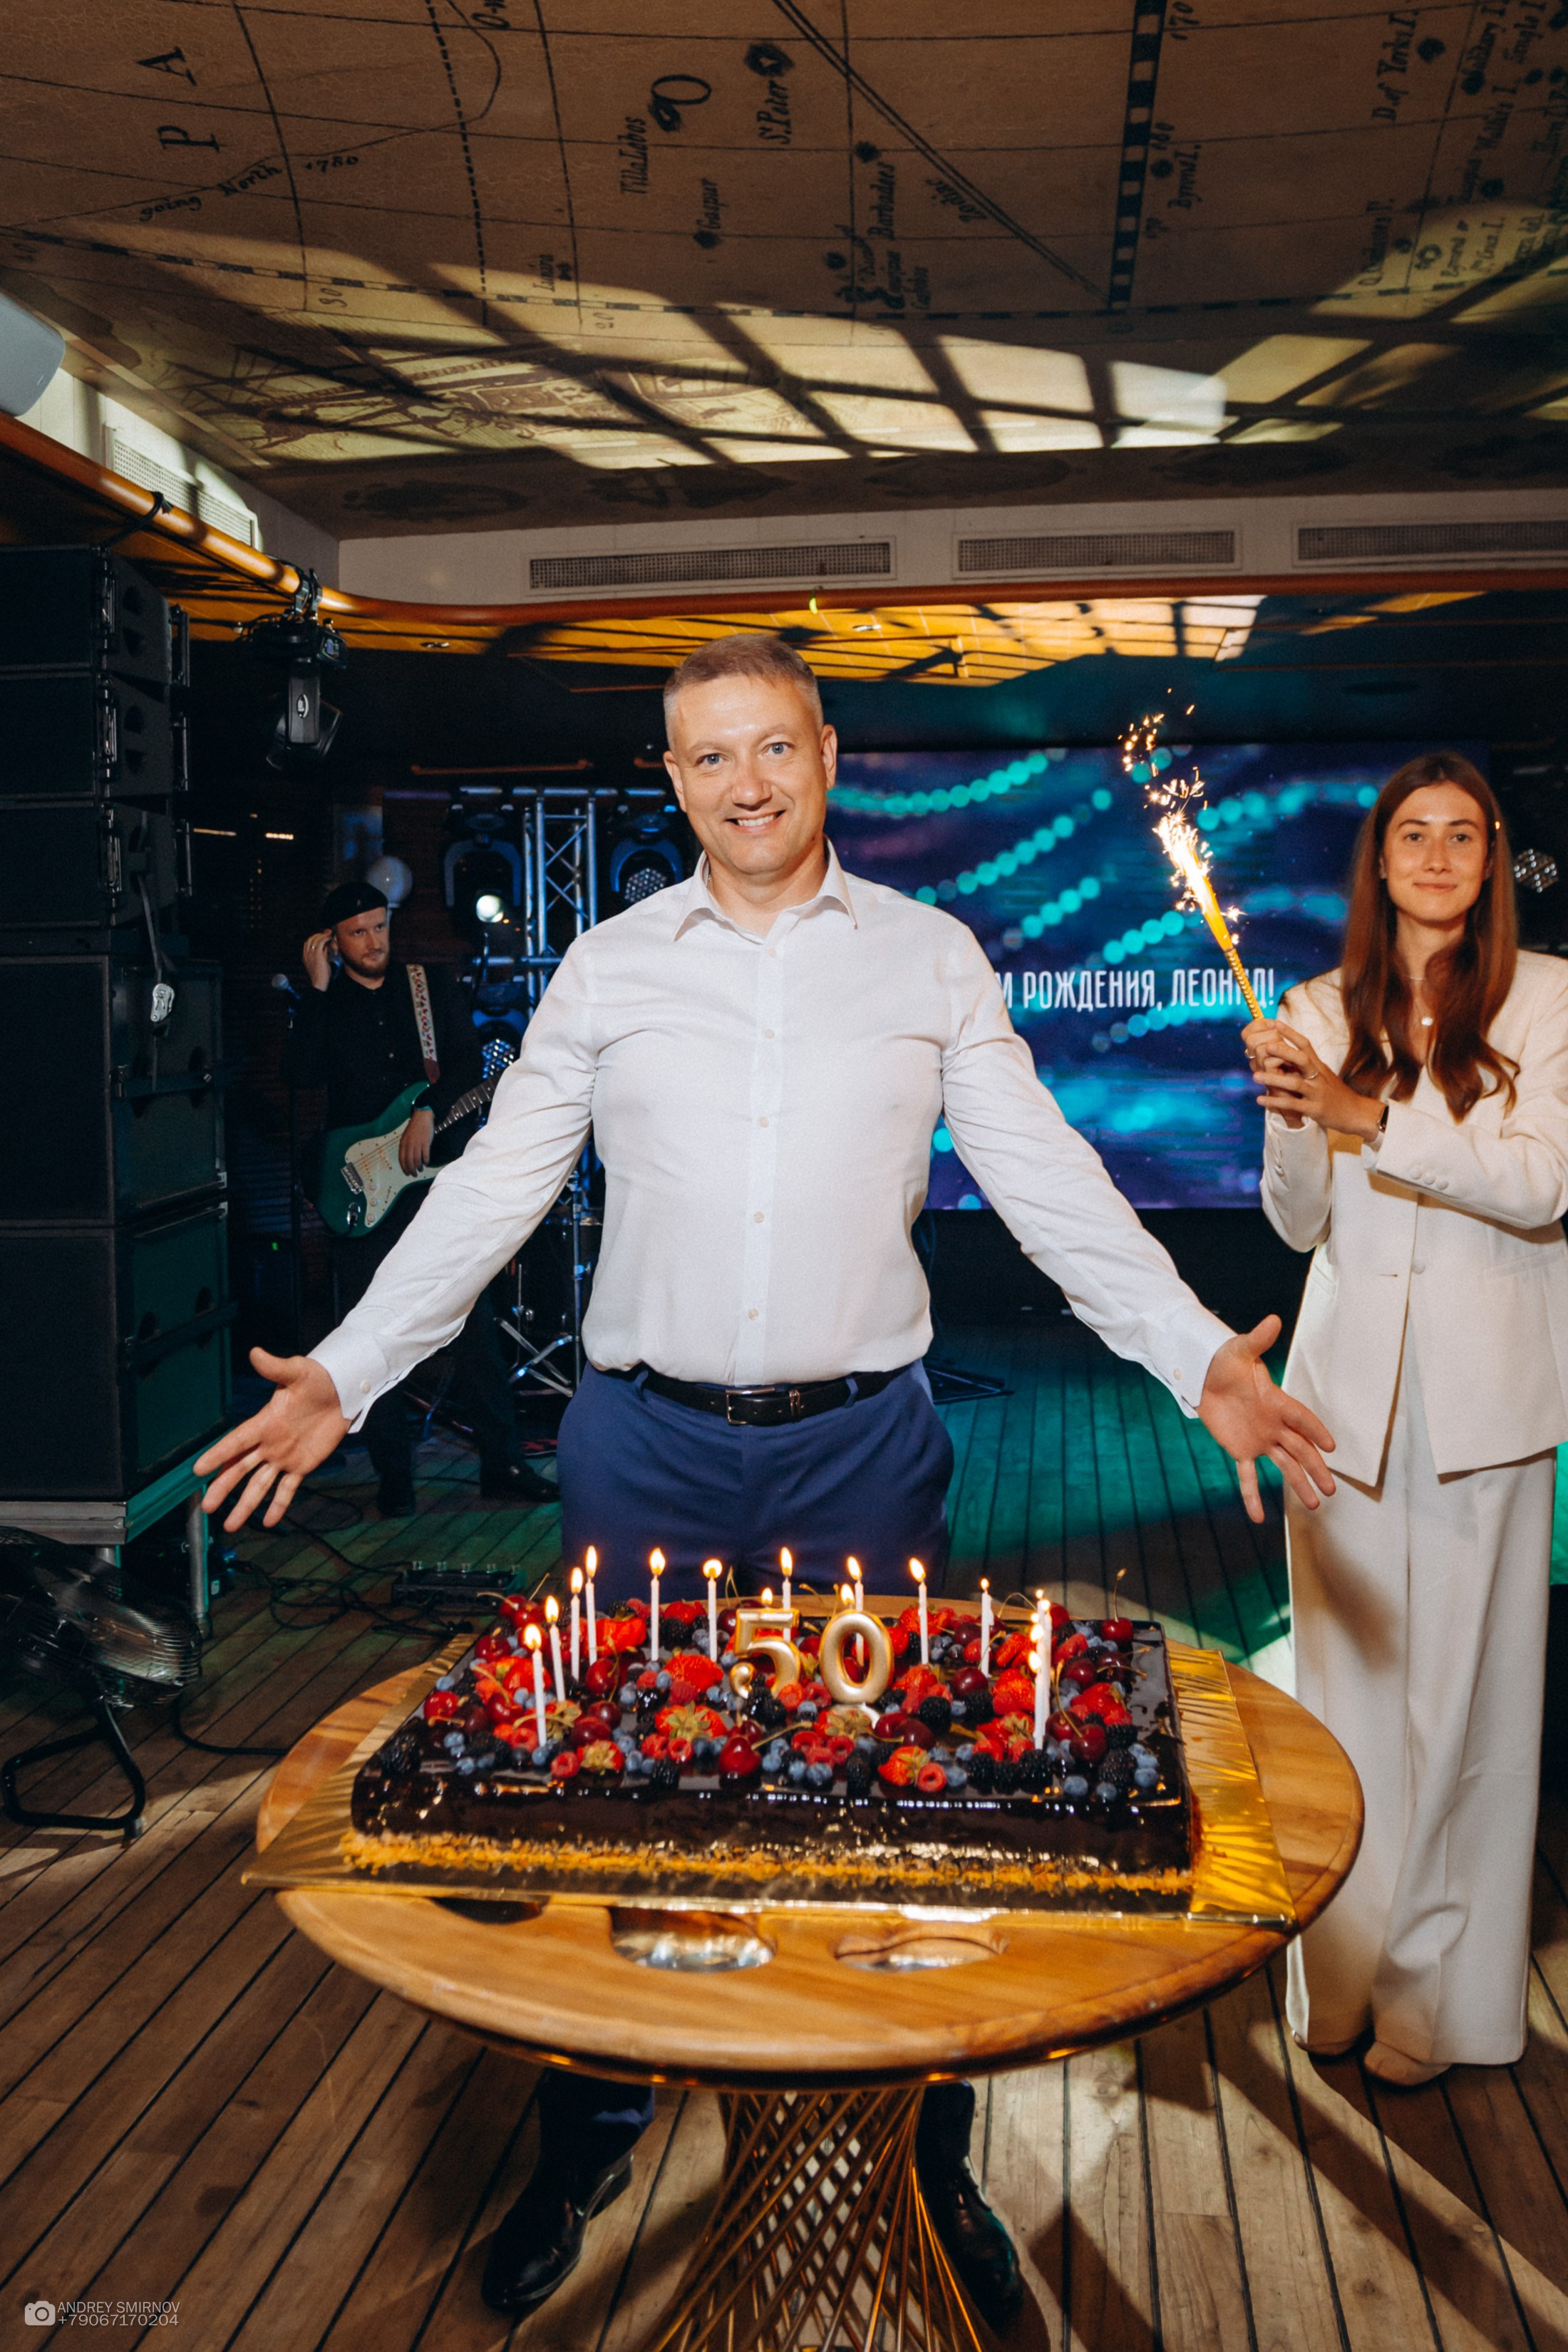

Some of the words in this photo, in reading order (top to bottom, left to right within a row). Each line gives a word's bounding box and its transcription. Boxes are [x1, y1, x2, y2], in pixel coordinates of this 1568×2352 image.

[139, 195, 202, 222] going
[217, 163, 282, 196] North
[1023, 969, 1162, 1012] РОЖДЕНИЯ,
[730, 1609, 894, 1704] 50
